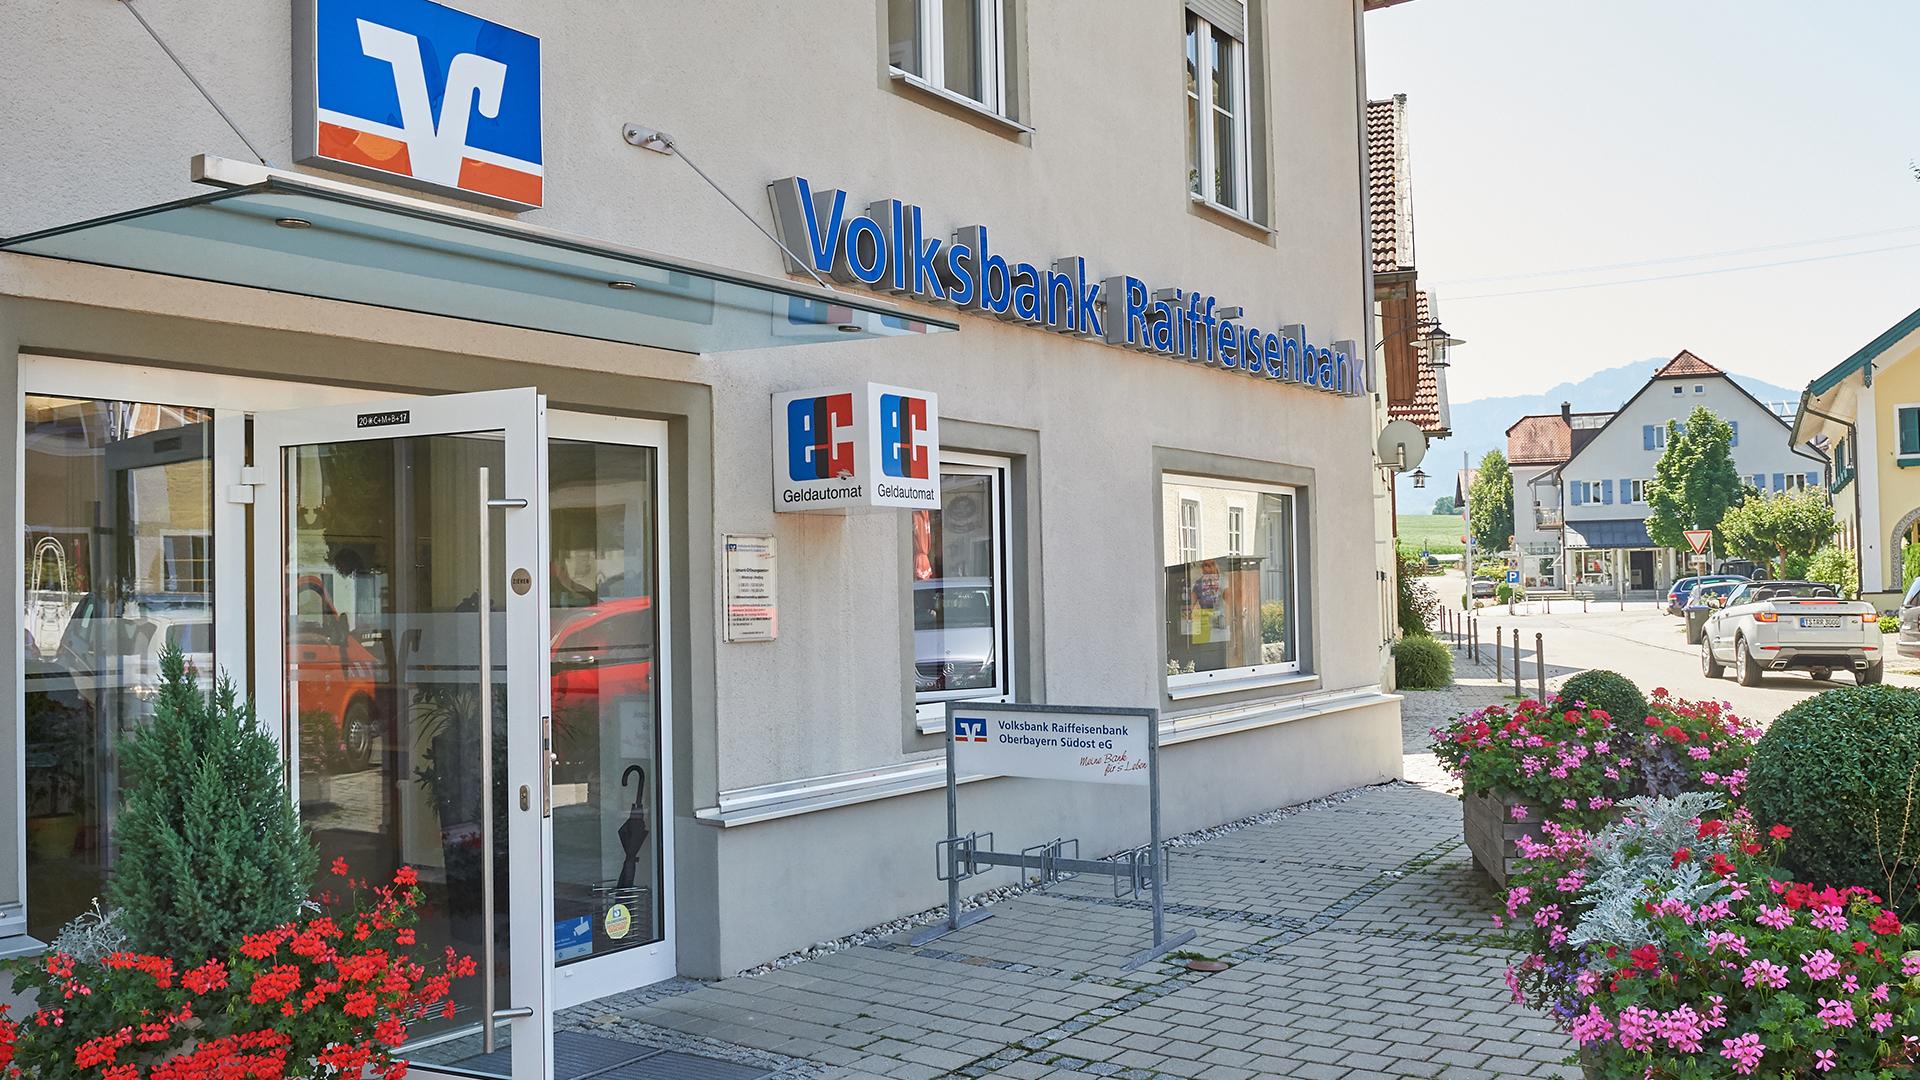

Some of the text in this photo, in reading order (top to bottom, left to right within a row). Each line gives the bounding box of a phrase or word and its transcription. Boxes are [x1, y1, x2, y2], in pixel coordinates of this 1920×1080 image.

[795, 174, 1366, 397] Volksbank Raiffeisenbank
[783, 485, 862, 503] Geldautomat
[877, 483, 935, 501] Geldautomat
[998, 720, 1129, 736] Volksbank Raiffeisenbank
[999, 733, 1113, 750] Oberbayern Südost eG
[1080, 750, 1128, 767] Meine Bank
[1124, 759, 1147, 771] Leben
